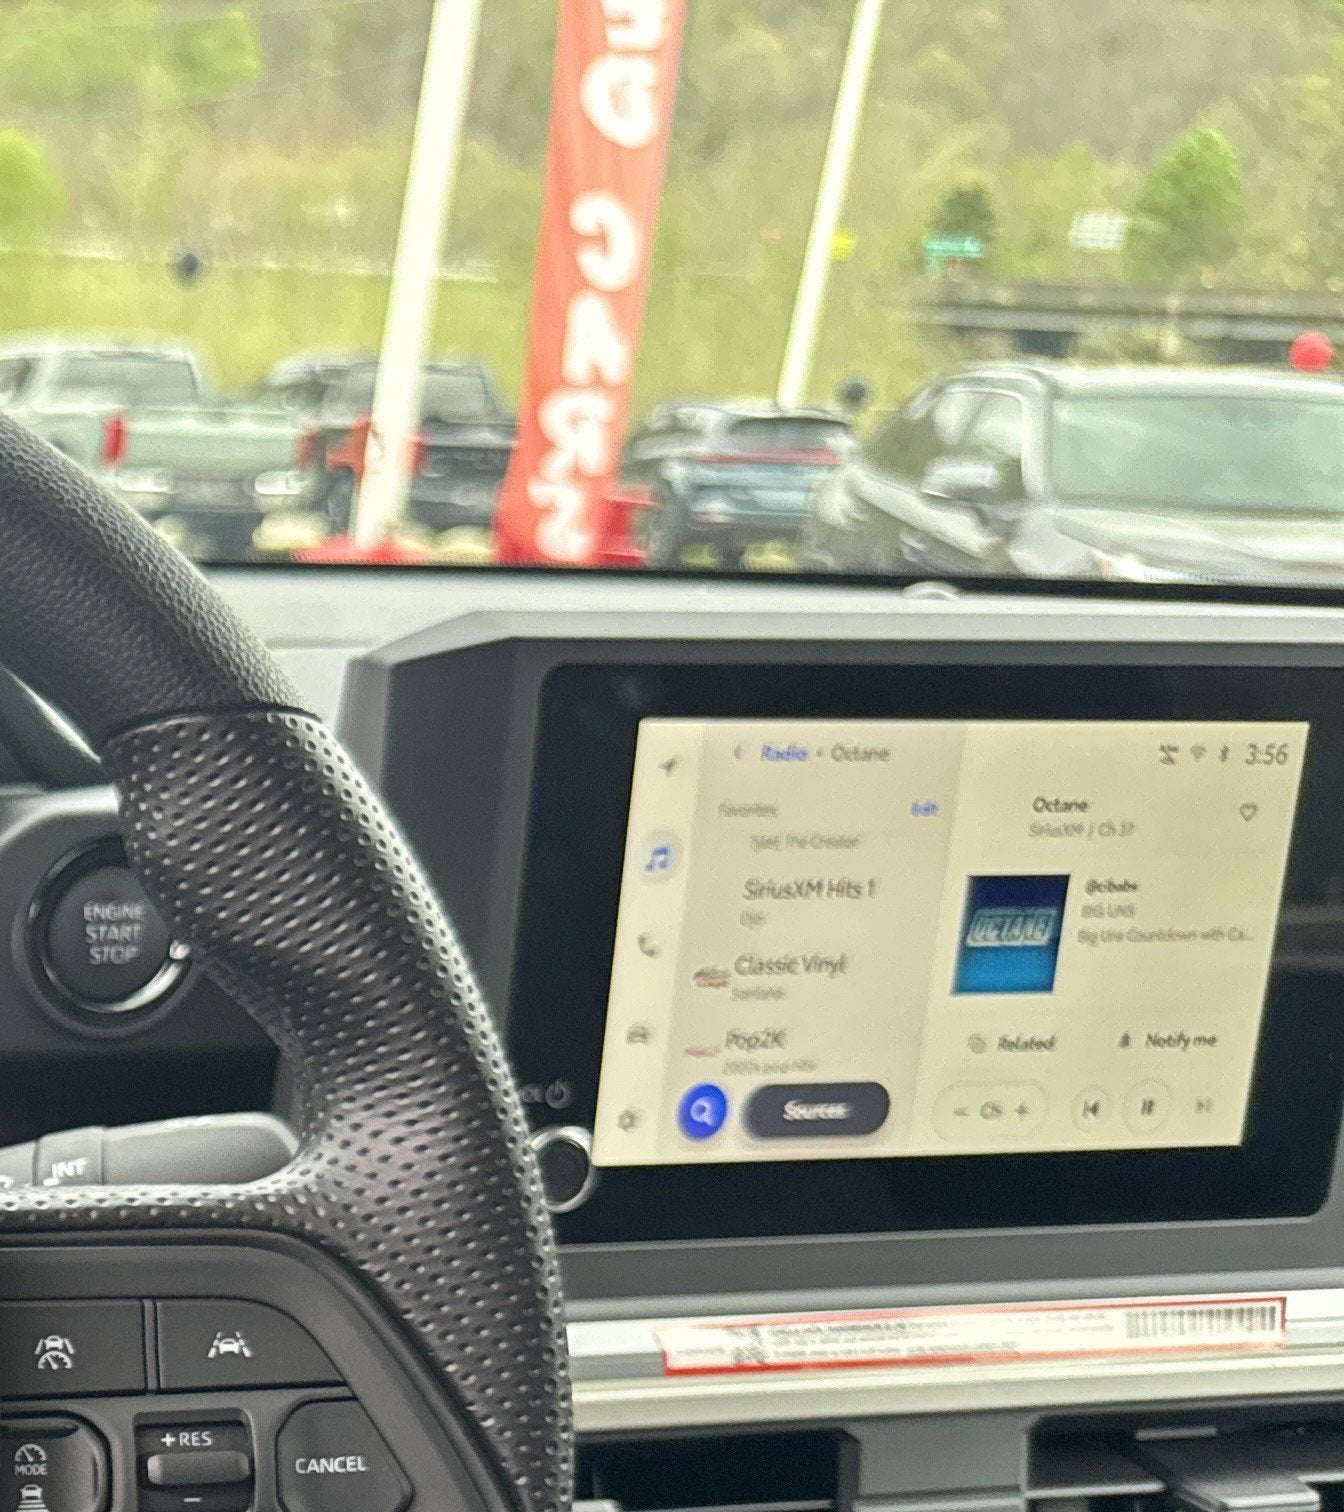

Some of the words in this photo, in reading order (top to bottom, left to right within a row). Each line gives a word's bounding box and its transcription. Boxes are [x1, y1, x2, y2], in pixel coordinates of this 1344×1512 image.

[761, 744, 809, 762] Radio
[831, 743, 891, 762] Octane
[1244, 744, 1289, 765] 3:56
[1032, 796, 1089, 813] Octane
[743, 877, 824, 900] SiriusXM
[826, 878, 863, 900] Hits
[83, 902, 145, 922] ENGINE
[85, 923, 141, 944] START
[88, 945, 140, 965] STOP
[734, 954, 799, 977] Classic
[801, 952, 847, 978] Vinyl
[997, 1033, 1057, 1051] Related
[1145, 1033, 1192, 1052] Notify
[1194, 1036, 1217, 1048] me
[783, 1101, 852, 1121] Sources
[52, 1157, 88, 1179] INT
[14, 1464, 48, 1476] MODE
[294, 1456, 367, 1475] CANCEL
